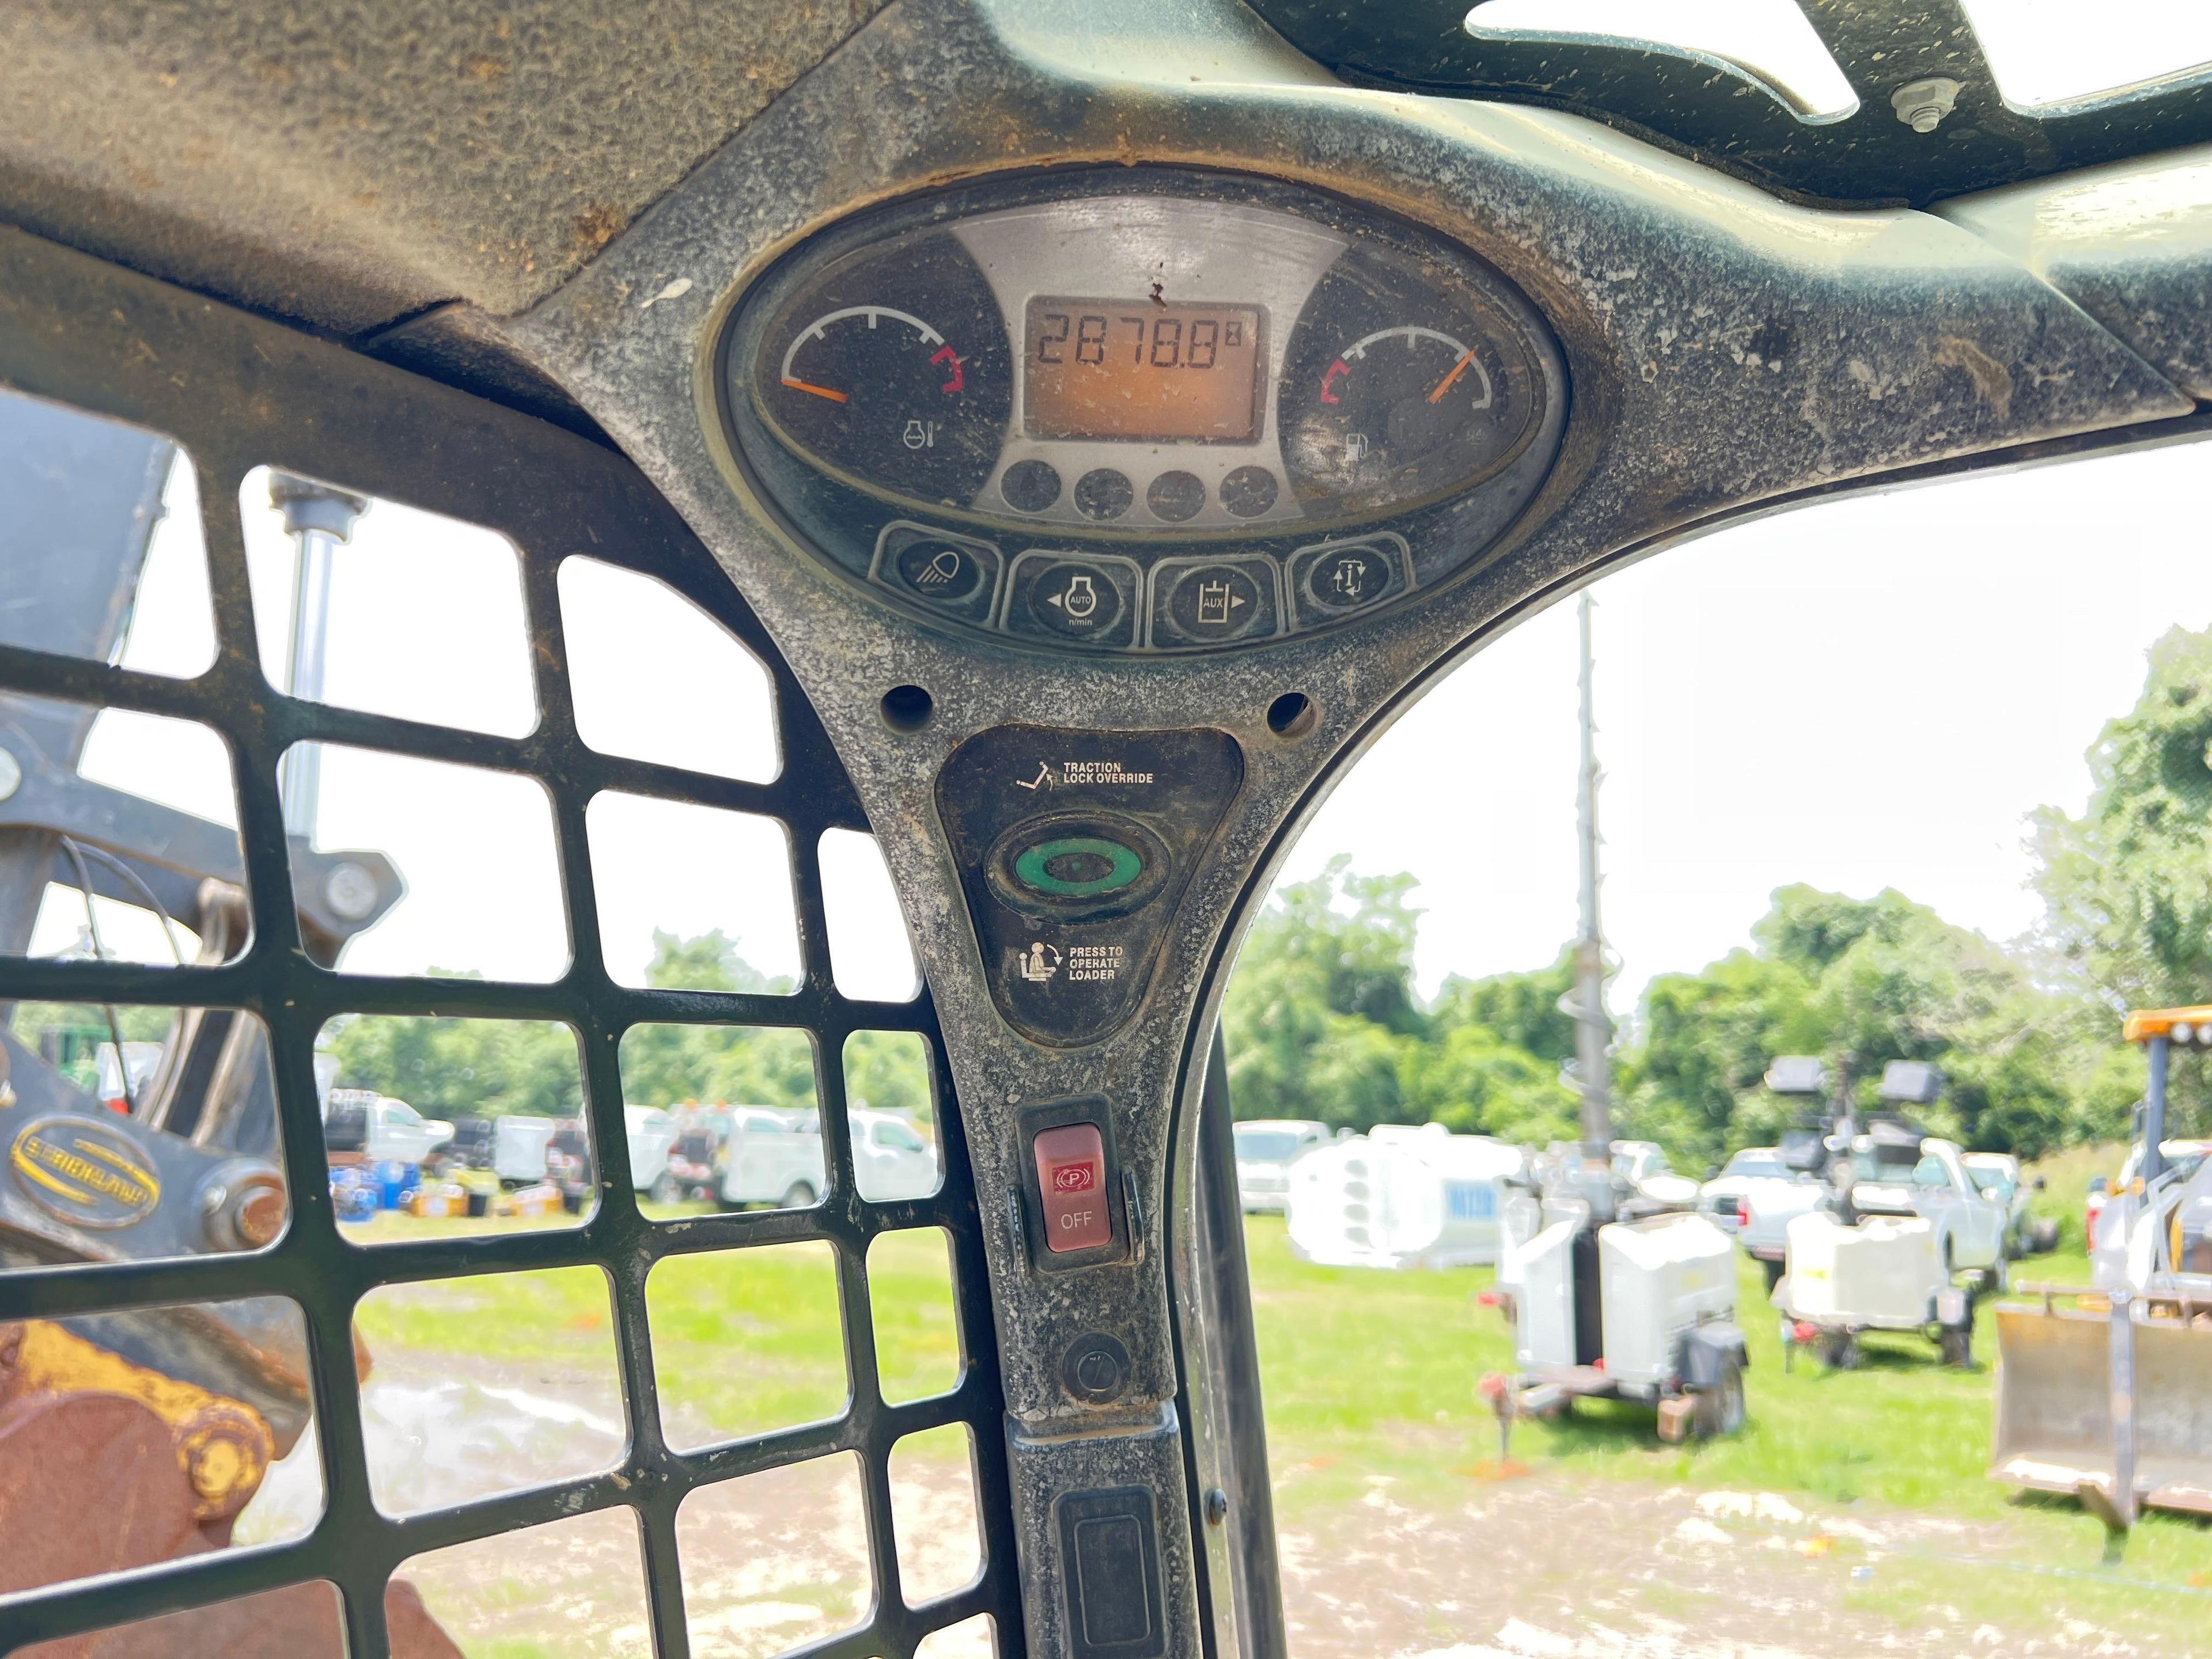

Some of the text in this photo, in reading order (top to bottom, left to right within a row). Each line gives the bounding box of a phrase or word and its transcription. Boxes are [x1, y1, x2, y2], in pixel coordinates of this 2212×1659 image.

[1039, 315, 1219, 369] 2878.8
[1070, 595, 1092, 605] AUTO
[1203, 598, 1224, 609] AUX
[1068, 618, 1093, 626] n/min
[1063, 762, 1122, 773] TRACTION
[1063, 772, 1153, 784] LOCK OVERRIDE
[1070, 946, 1124, 957] PRESS TO
[1069, 958, 1120, 969] OPERATE
[1069, 969, 1115, 980] LOADER
[1069, 1173, 1080, 1185] P
[1060, 1210, 1092, 1230] OFF
